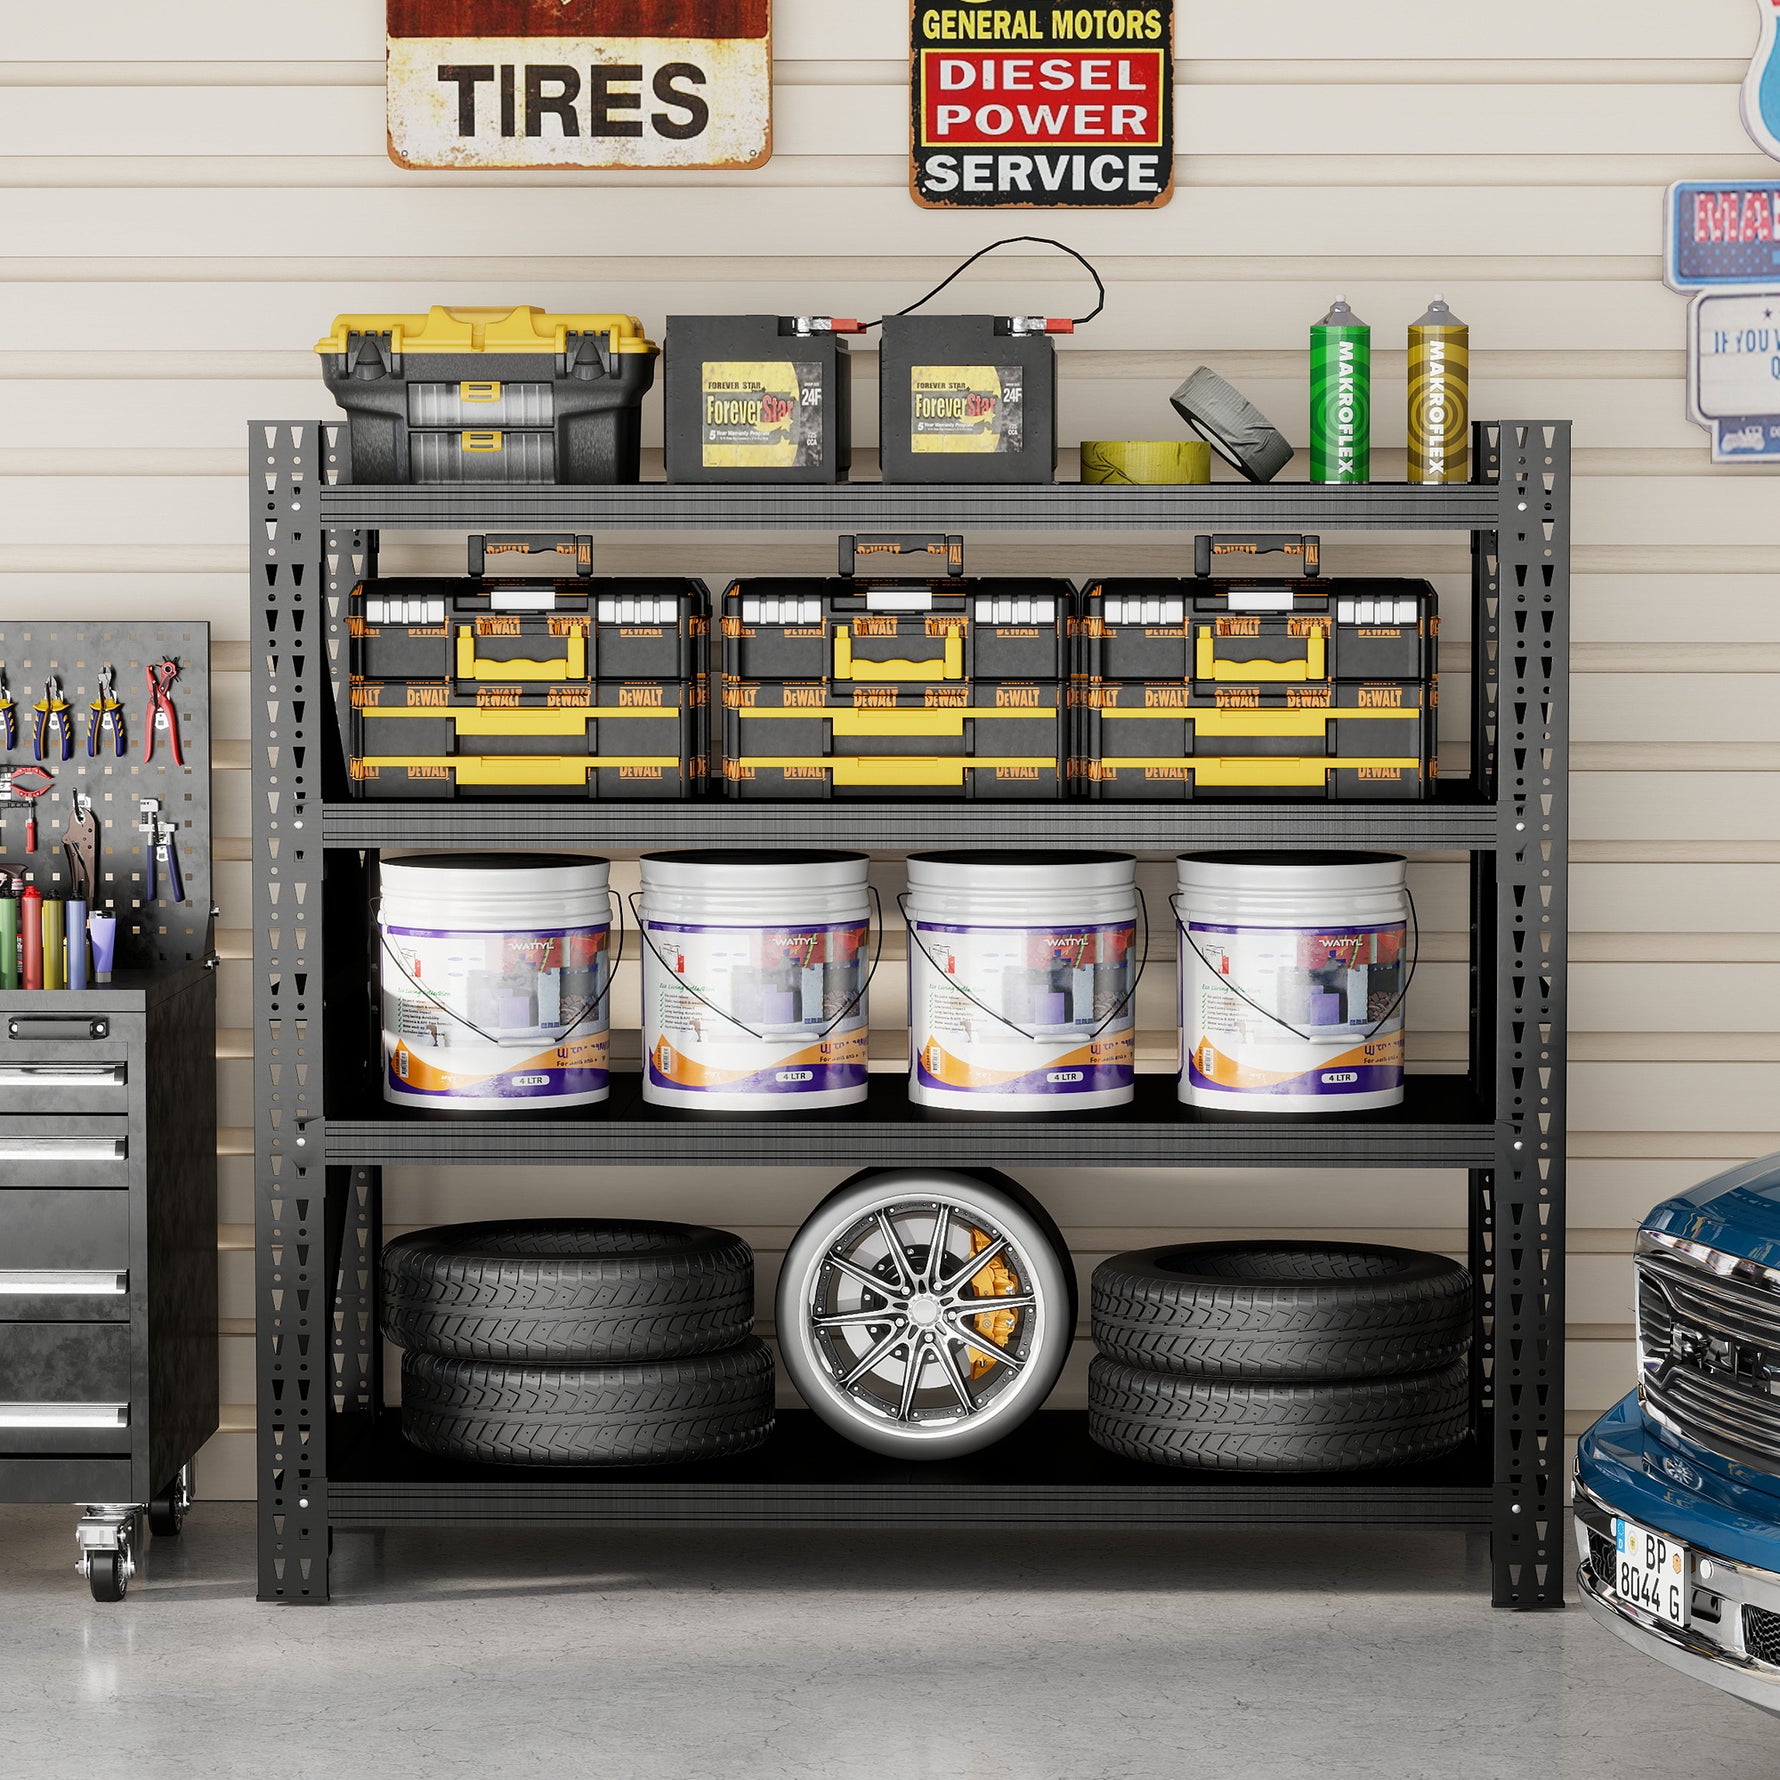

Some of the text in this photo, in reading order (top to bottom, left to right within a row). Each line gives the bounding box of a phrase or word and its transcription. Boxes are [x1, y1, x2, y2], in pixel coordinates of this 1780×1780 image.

[922, 9, 1162, 40] GENERAL MOTORS
[939, 58, 1146, 91] DIESEL
[437, 62, 708, 140] TIRES
[938, 104, 1148, 136] POWER
[924, 154, 1159, 193] SERVICE
[1694, 192, 1780, 243] MA
[708, 382, 761, 390] FOREVER STAR
[801, 388, 822, 406] 24F
[1003, 388, 1022, 403] 24F
[1338, 341, 1354, 474] MAKROFLEX
[1429, 340, 1445, 474] MAKROFLEX
[917, 422, 924, 431] 5
[709, 430, 716, 440] 5
[508, 941, 554, 951] WATTYL
[772, 937, 818, 946] WATTYL
[1043, 937, 1089, 946] WATTYL
[1318, 938, 1364, 948] WATTYL
[527, 1076, 543, 1084] LTR
[791, 1072, 806, 1080] LTR
[1062, 1073, 1077, 1081] LTR
[1336, 1074, 1352, 1082] LTR
[1645, 1533, 1667, 1574] BP
[1621, 1561, 1680, 1622] 8044 G
